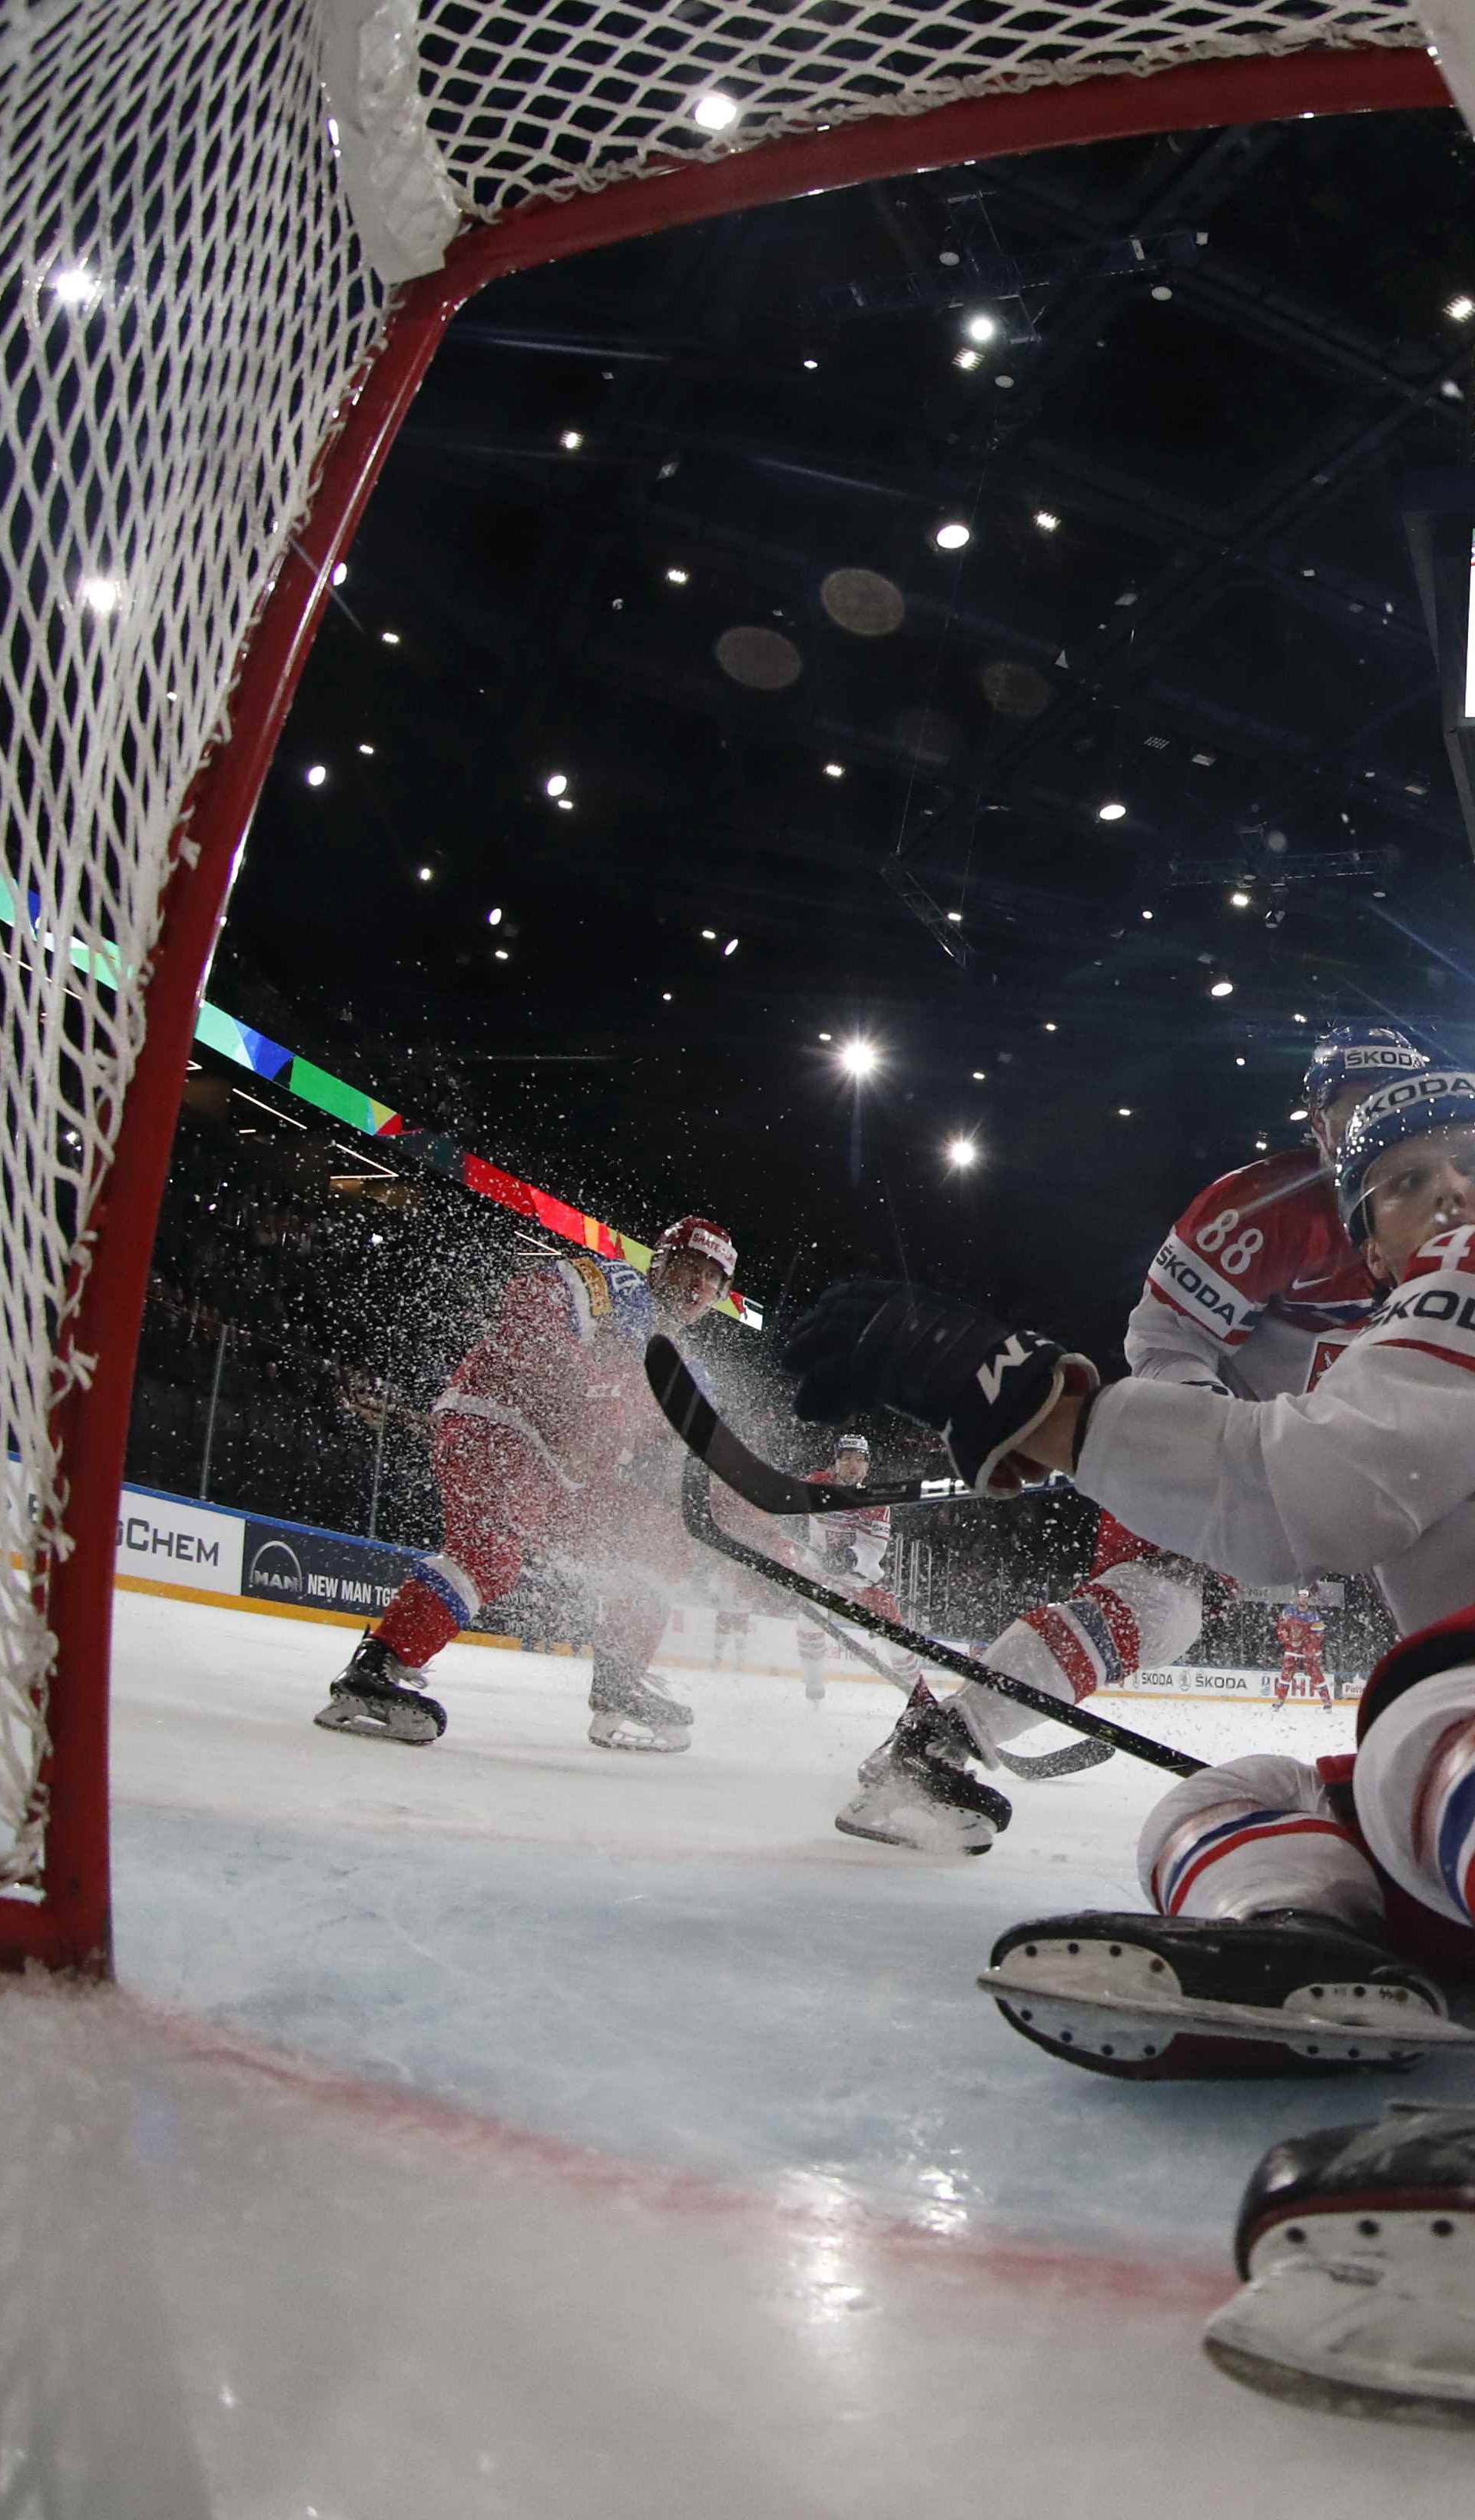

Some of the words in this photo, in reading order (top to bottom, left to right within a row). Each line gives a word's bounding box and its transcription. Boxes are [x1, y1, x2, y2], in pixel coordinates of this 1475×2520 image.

[1196, 1209, 1264, 1275] 88
[1155, 1244, 1235, 1326] ŠKODA
[254, 1570, 299, 1593] MAN
[307, 1573, 338, 1598] NEW
[341, 1580, 372, 1604] MAN
